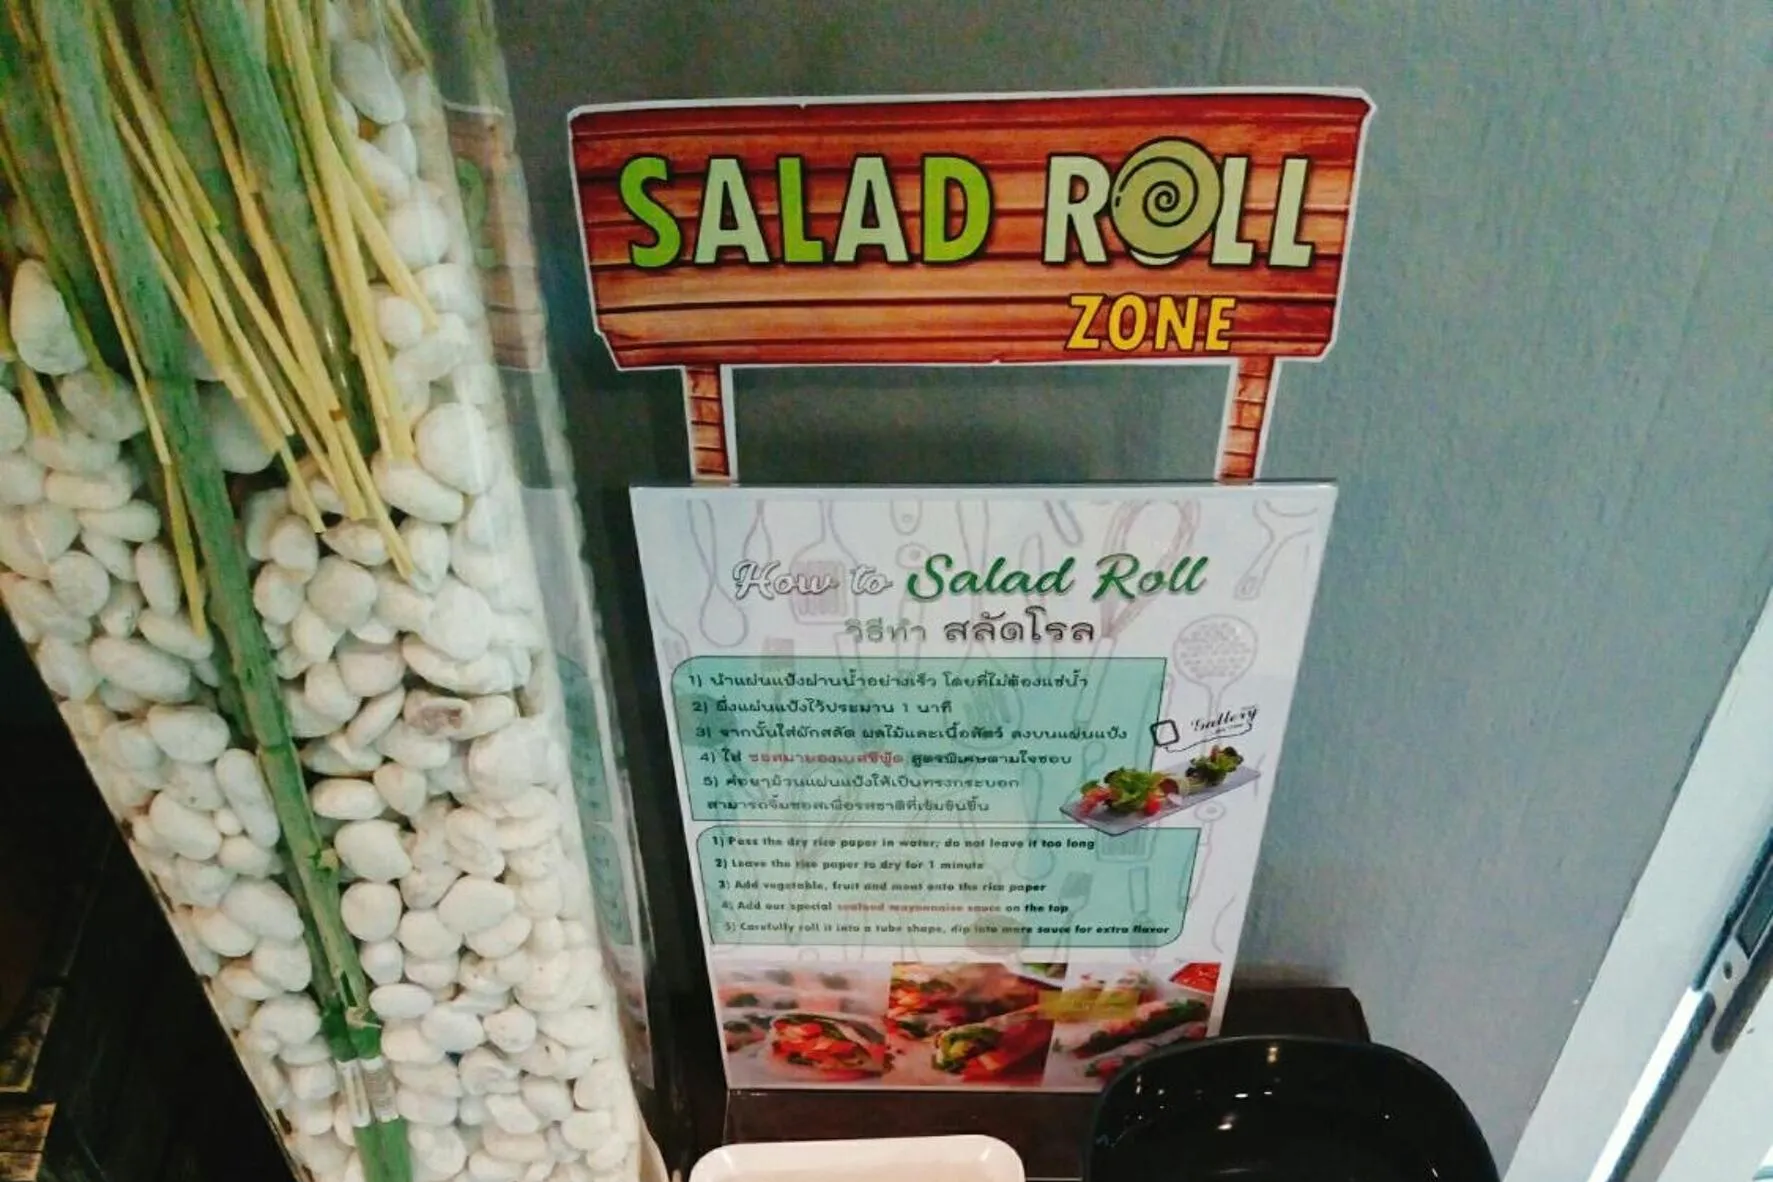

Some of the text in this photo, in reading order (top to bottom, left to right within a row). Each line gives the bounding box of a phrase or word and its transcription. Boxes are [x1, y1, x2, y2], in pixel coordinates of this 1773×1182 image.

[616, 136, 1315, 269] SALAD ROLL
[1064, 292, 1239, 353] ZONE
[731, 553, 1210, 601] How to Salad Roll
[843, 604, 1096, 644] วิธีทำ สลัดโรล
[688, 674, 703, 688] 1)
[692, 701, 709, 714] 2)
[916, 700, 953, 714] นาที
[695, 726, 712, 739] 3)
[699, 752, 716, 764] 4)
[720, 747, 742, 763] ใส่
[703, 775, 719, 787] 5)
[711, 836, 724, 848] 1)
[728, 836, 759, 847] Pass
[763, 836, 783, 847] the
[787, 836, 808, 849] dry
[813, 836, 835, 847] rice
[840, 838, 877, 849] paper
[882, 837, 895, 847] in
[944, 838, 960, 847] do
[965, 838, 985, 848] not
[989, 838, 1024, 848] leave
[1028, 838, 1038, 848] it
[1041, 838, 1062, 848] too
[1066, 838, 1095, 850] long
[714, 858, 728, 869] 2)
[731, 858, 767, 869] Leave
[771, 858, 791, 868] the
[796, 858, 818, 869] rice
[822, 860, 859, 871] paper
[863, 859, 876, 869] to
[880, 858, 901, 871] dry
[905, 858, 923, 869] for
[940, 860, 984, 869] minute
[718, 880, 730, 890] 3)
[734, 880, 758, 890] Add
[832, 881, 860, 890] fruit
[864, 881, 887, 891] and
[958, 882, 978, 891] the
[982, 882, 1004, 891] rice
[1008, 883, 1047, 893] paper
[737, 901, 761, 911] Add
[765, 903, 785, 911] our
[790, 901, 832, 913] special
[1005, 904, 1020, 913] on
[1024, 903, 1045, 913] the
[1048, 903, 1069, 914] top
[740, 921, 794, 933] Carefully
[799, 922, 819, 932] roll
[836, 923, 860, 932] into
[875, 923, 902, 933] tube
[950, 924, 971, 936] dip
[974, 925, 998, 934] into
[1001, 926, 1033, 934] more
[1037, 926, 1070, 934] sauce
[1074, 924, 1092, 934] for
[1096, 925, 1129, 934] extra
[1133, 924, 1170, 934] flavor
